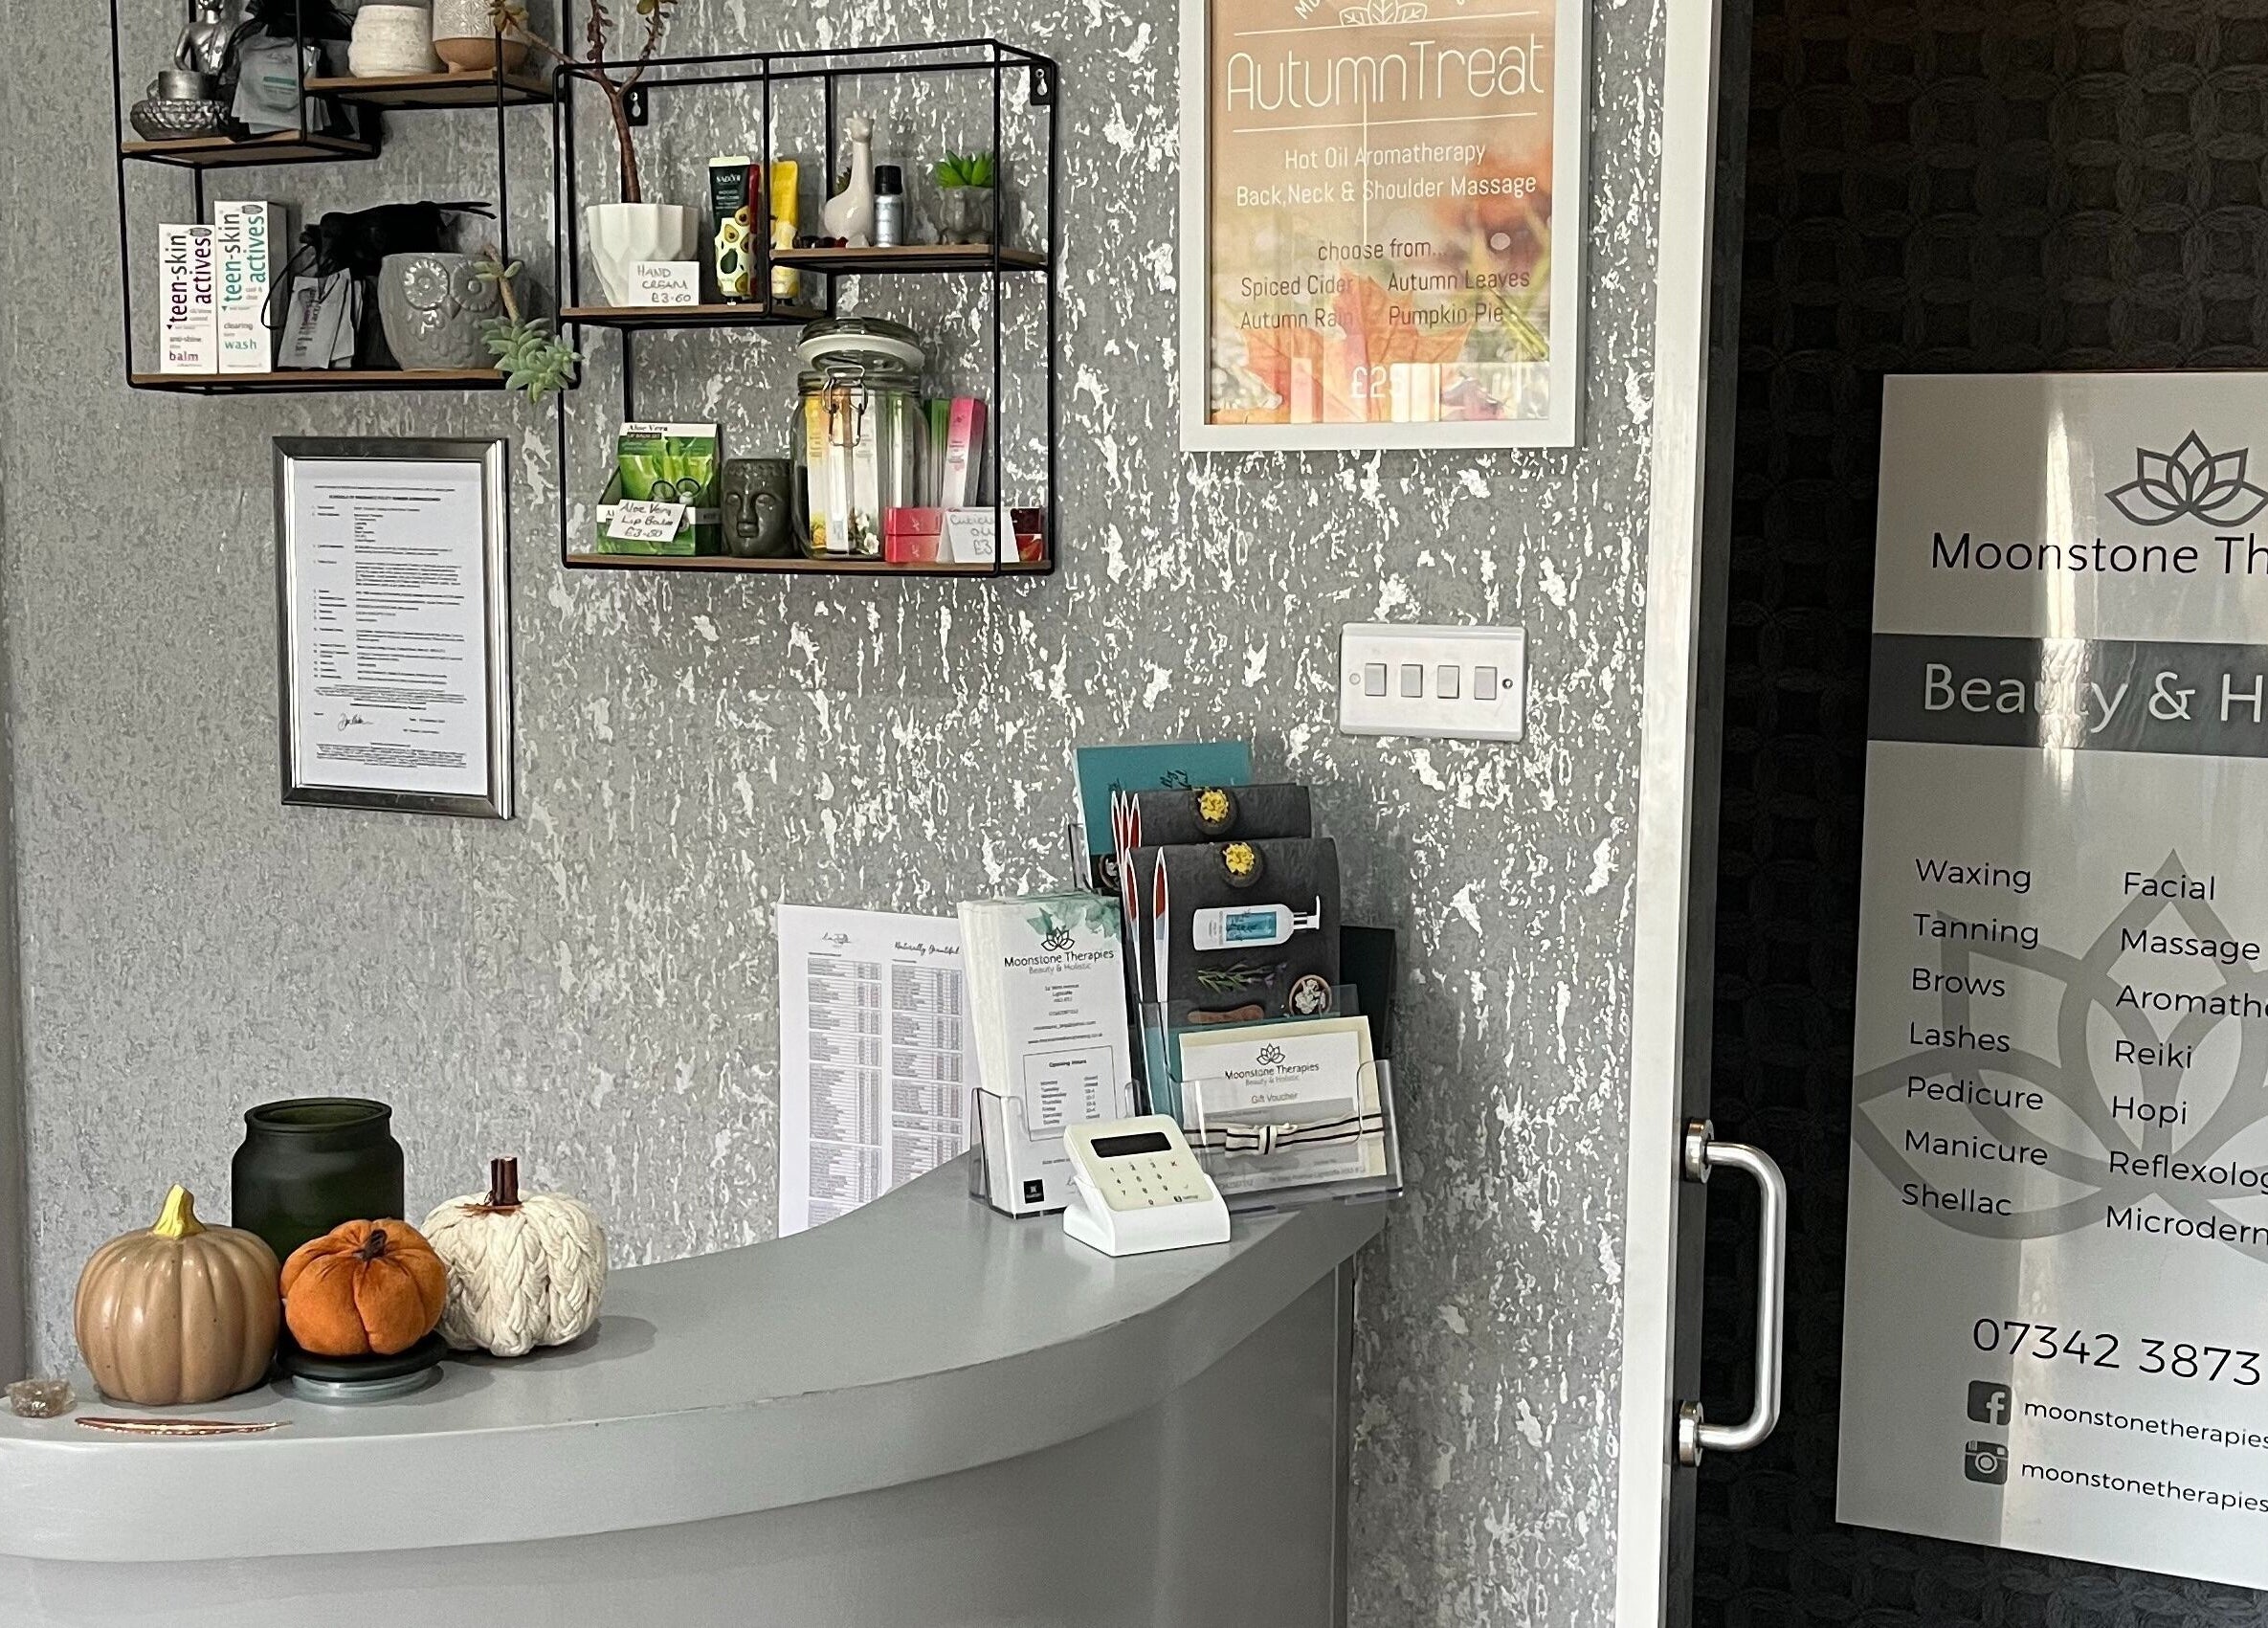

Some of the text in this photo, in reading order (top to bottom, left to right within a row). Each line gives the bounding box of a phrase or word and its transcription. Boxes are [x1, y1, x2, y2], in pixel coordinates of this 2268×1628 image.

[1285, 143, 1486, 170] Hot Oil Aromatherapy
[1341, 181, 1355, 202] &
[1363, 177, 1444, 201] Shoulder
[1451, 174, 1538, 199] Massage
[218, 213, 242, 302] teen-skin
[243, 215, 266, 283] actives
[1318, 239, 1384, 261] choose
[165, 234, 188, 323] teen-skin
[189, 236, 211, 304] actives
[637, 264, 672, 278] HAND
[642, 279, 688, 290] CREAM
[1387, 270, 1530, 292] Autumn Leaves
[1241, 275, 1353, 301] Spiced Cider
[223, 322, 254, 331] clearing
[1240, 311, 1308, 330] Autumn
[1390, 301, 1504, 328] Pumpkin Pie
[169, 350, 199, 362] balm
[225, 338, 257, 350] wash
[621, 515, 642, 525] Lip
[1931, 532, 2199, 574] Moonstone
[2147, 671, 2197, 722] &
[2220, 673, 2264, 724] H
[1915, 858, 2033, 894] Waxing
[2123, 872, 2215, 901] Facial
[1913, 913, 2039, 950] Tanning
[2120, 927, 2260, 965] Massage
[1004, 949, 1115, 968] Moonstone Therapies
[1912, 968, 2006, 997] Brows
[2115, 985, 2268, 1018] Aromath
[1909, 1022, 2011, 1053] Lashes
[2115, 1039, 2192, 1070] Reiki
[1225, 1062, 1320, 1080] Moonstone Therapies
[1907, 1076, 2045, 1110] Pedicure
[2112, 1096, 2188, 1129] Hopi
[1904, 1129, 2049, 1166] Manicure
[1901, 1183, 2012, 1216] Shellac
[1973, 1318, 2261, 1386] 07342 3873
[2021, 1461, 2268, 1513] moonstonetherapies
